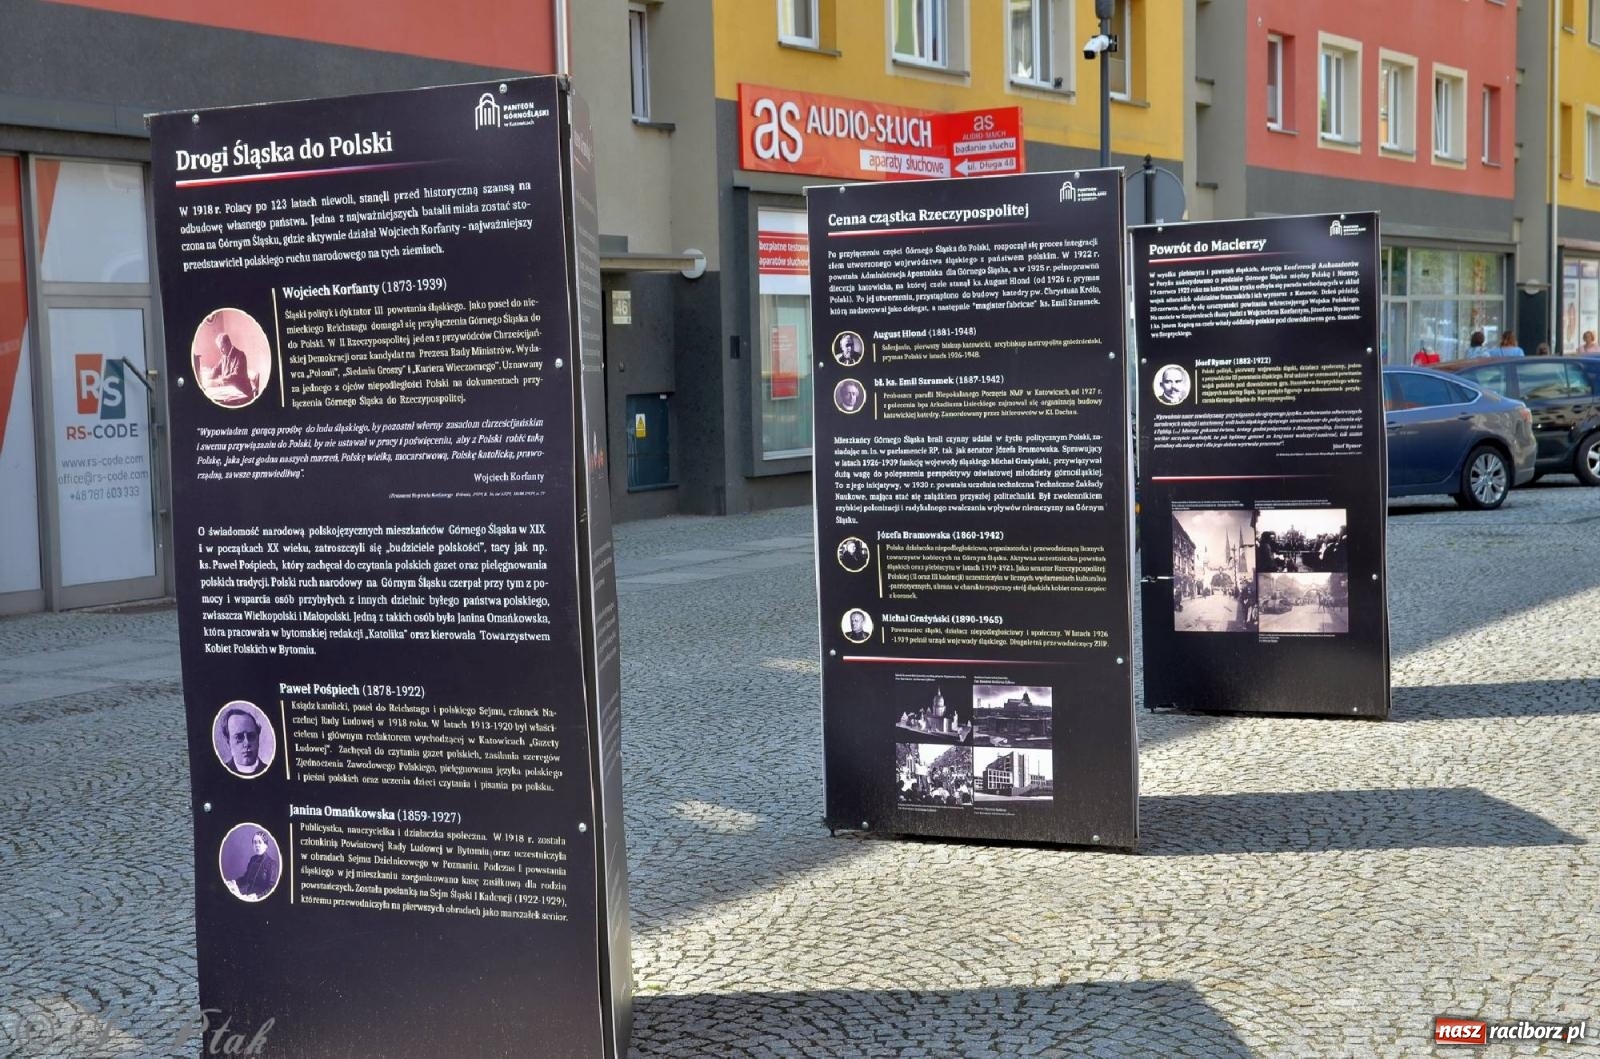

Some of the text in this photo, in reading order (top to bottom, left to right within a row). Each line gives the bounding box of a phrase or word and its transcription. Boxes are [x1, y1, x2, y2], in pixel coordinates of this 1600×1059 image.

[504, 102, 534, 111] PANTEON
[504, 109, 550, 120] GÓRNOŚLĄSKI
[754, 98, 804, 162] as
[807, 105, 932, 148] AUDIO-SŁUCH
[974, 115, 994, 132] as
[175, 131, 393, 173] Drogi Śląska do Polski
[956, 141, 1014, 154] badanie słuchu
[869, 155, 944, 174] aparaty słuchowe
[980, 161, 1002, 169] Długa
[178, 206, 188, 216] W
[192, 204, 213, 215] 1918
[224, 202, 252, 214] Polacy
[255, 202, 267, 213] po
[270, 198, 287, 210] 123
[290, 196, 317, 208] latach
[321, 193, 356, 206] niewoli,
[359, 190, 390, 204] stanęli
[393, 188, 420, 203] przed
[423, 186, 478, 198] historyczną
[482, 183, 514, 194] szansą
[518, 181, 531, 190] na
[828, 202, 1029, 226] Cenna cząstka Rzeczypospolitej
[1149, 237, 1266, 255] Powrót do Macierzy
[182, 243, 444, 272] przedstawiciel polskiego ruchu narodowego na tych ziemiach.
[282, 278, 446, 300] Wojciech Korfanty (1873-1939)
[873, 326, 976, 340] August Hlond (1881-1948)
[80, 370, 122, 406] RS
[66, 423, 138, 440] RS-CODE
[61, 454, 144, 468] www.rs-code.com
[58, 470, 149, 486] office@rs-code.com
[473, 471, 544, 483] Wojciech Korfanty
[197, 526, 205, 536] O
[208, 525, 259, 536] świadomość
[262, 525, 304, 537] narodową
[308, 524, 383, 538] polskojęzycznych
[385, 524, 444, 534] mieszkańców
[448, 524, 486, 536] Górnego
[487, 522, 516, 536] Śląska
[529, 523, 546, 533] XIX
[877, 530, 1004, 540] Józefa Bramowska (1860-1942)
[199, 559, 211, 569] ks.
[212, 559, 238, 569] Paweł
[238, 559, 278, 572] Pośpiech,
[282, 559, 304, 572] który
[306, 559, 342, 572] zachęcał
[343, 559, 356, 569] do
[356, 559, 392, 572] czytania
[394, 559, 431, 572] polskich
[433, 561, 456, 572] gazet
[480, 559, 547, 572] pielęgnowania
[203, 626, 226, 636] która
[227, 627, 270, 638] pracowała
[281, 627, 327, 640] bytomskiej
[329, 628, 363, 640] redakcji
[409, 631, 429, 639] oraz
[430, 629, 476, 639] kierowała
[479, 630, 550, 643] Towarzystwem
[204, 643, 232, 653] Kobiet
[233, 643, 268, 653] Polskich
[278, 644, 316, 656] Bytomiu.
[279, 682, 424, 698] Paweł Pośpiech (1878-1922)
[289, 804, 461, 824] Janina Omańkowska (1859-1927)
